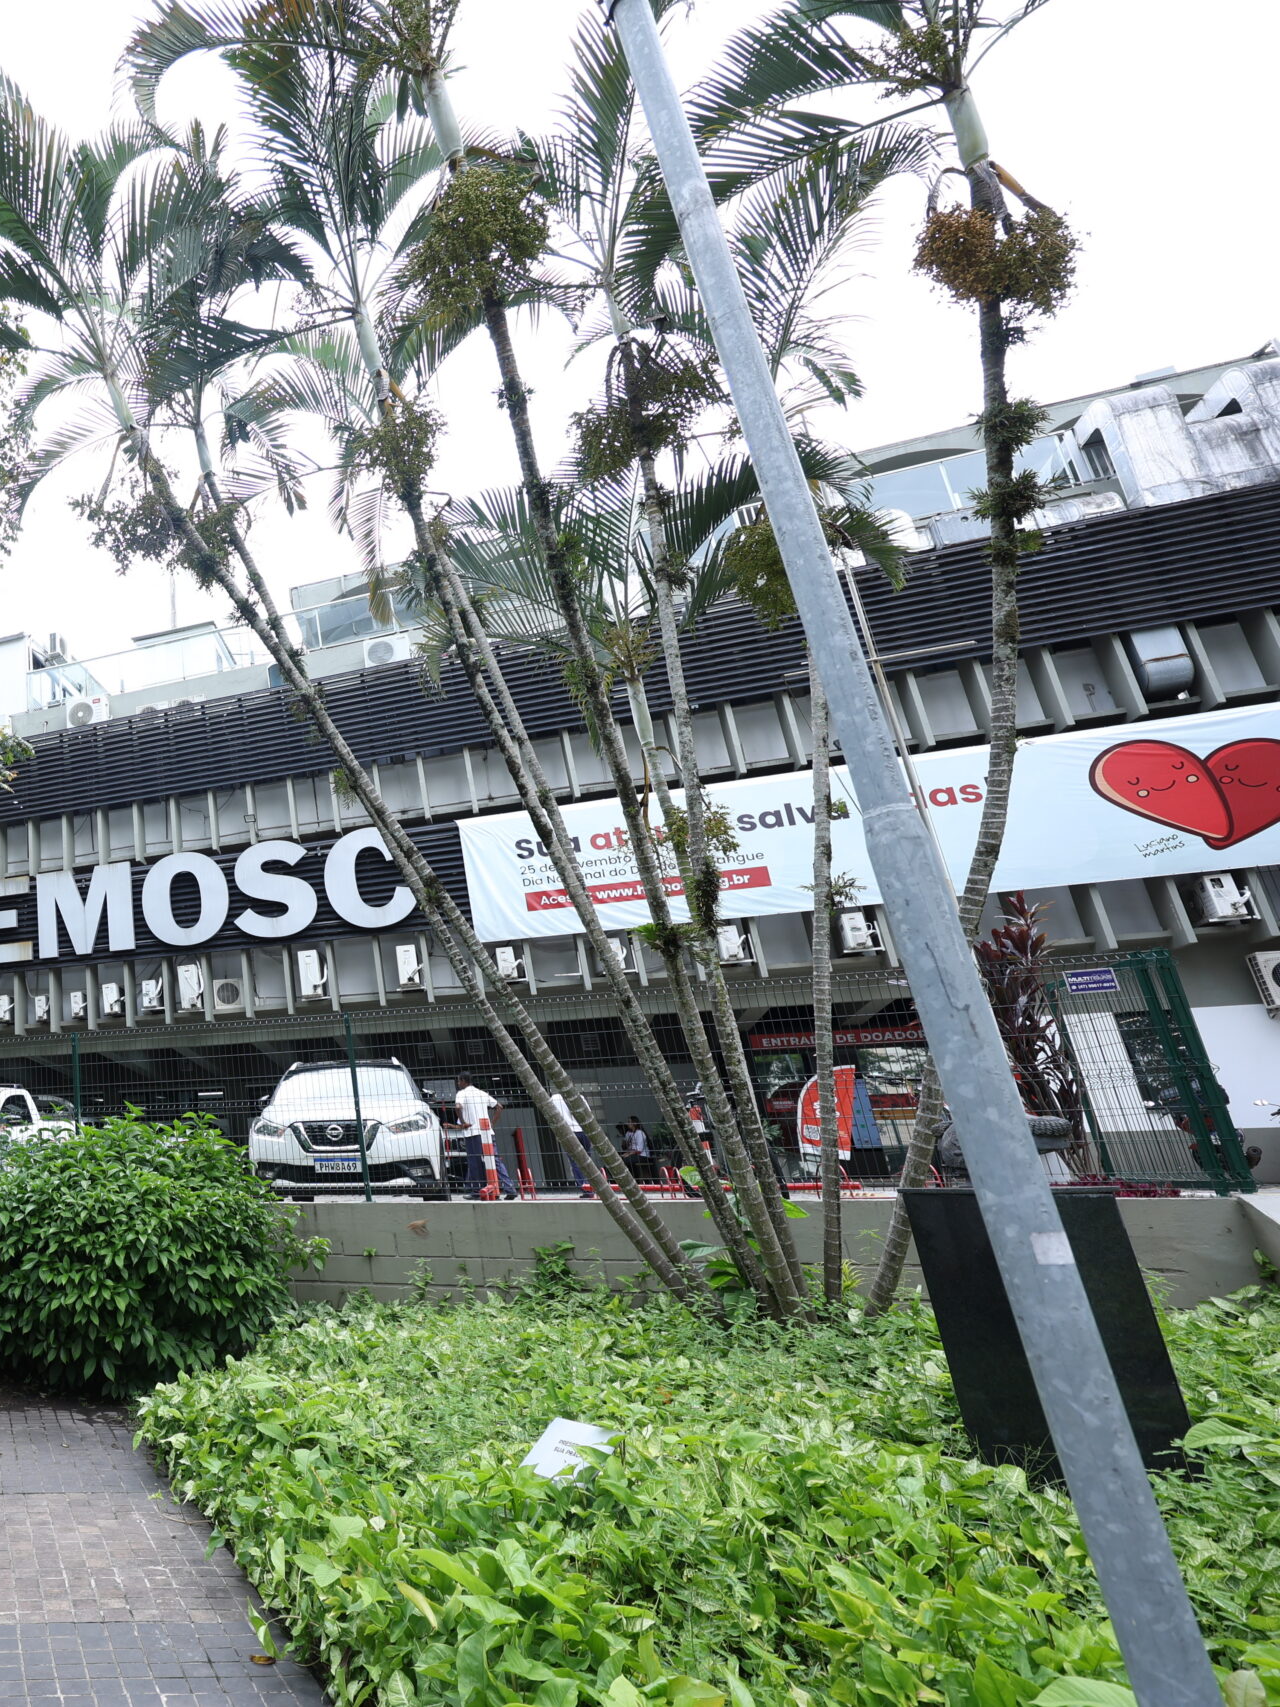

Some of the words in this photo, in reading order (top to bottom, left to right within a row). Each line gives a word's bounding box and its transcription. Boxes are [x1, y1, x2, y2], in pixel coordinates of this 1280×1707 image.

[520, 865, 536, 875] 25
[522, 876, 543, 887] Dia
[609, 868, 627, 877] do
[835, 1033, 857, 1043] DE
